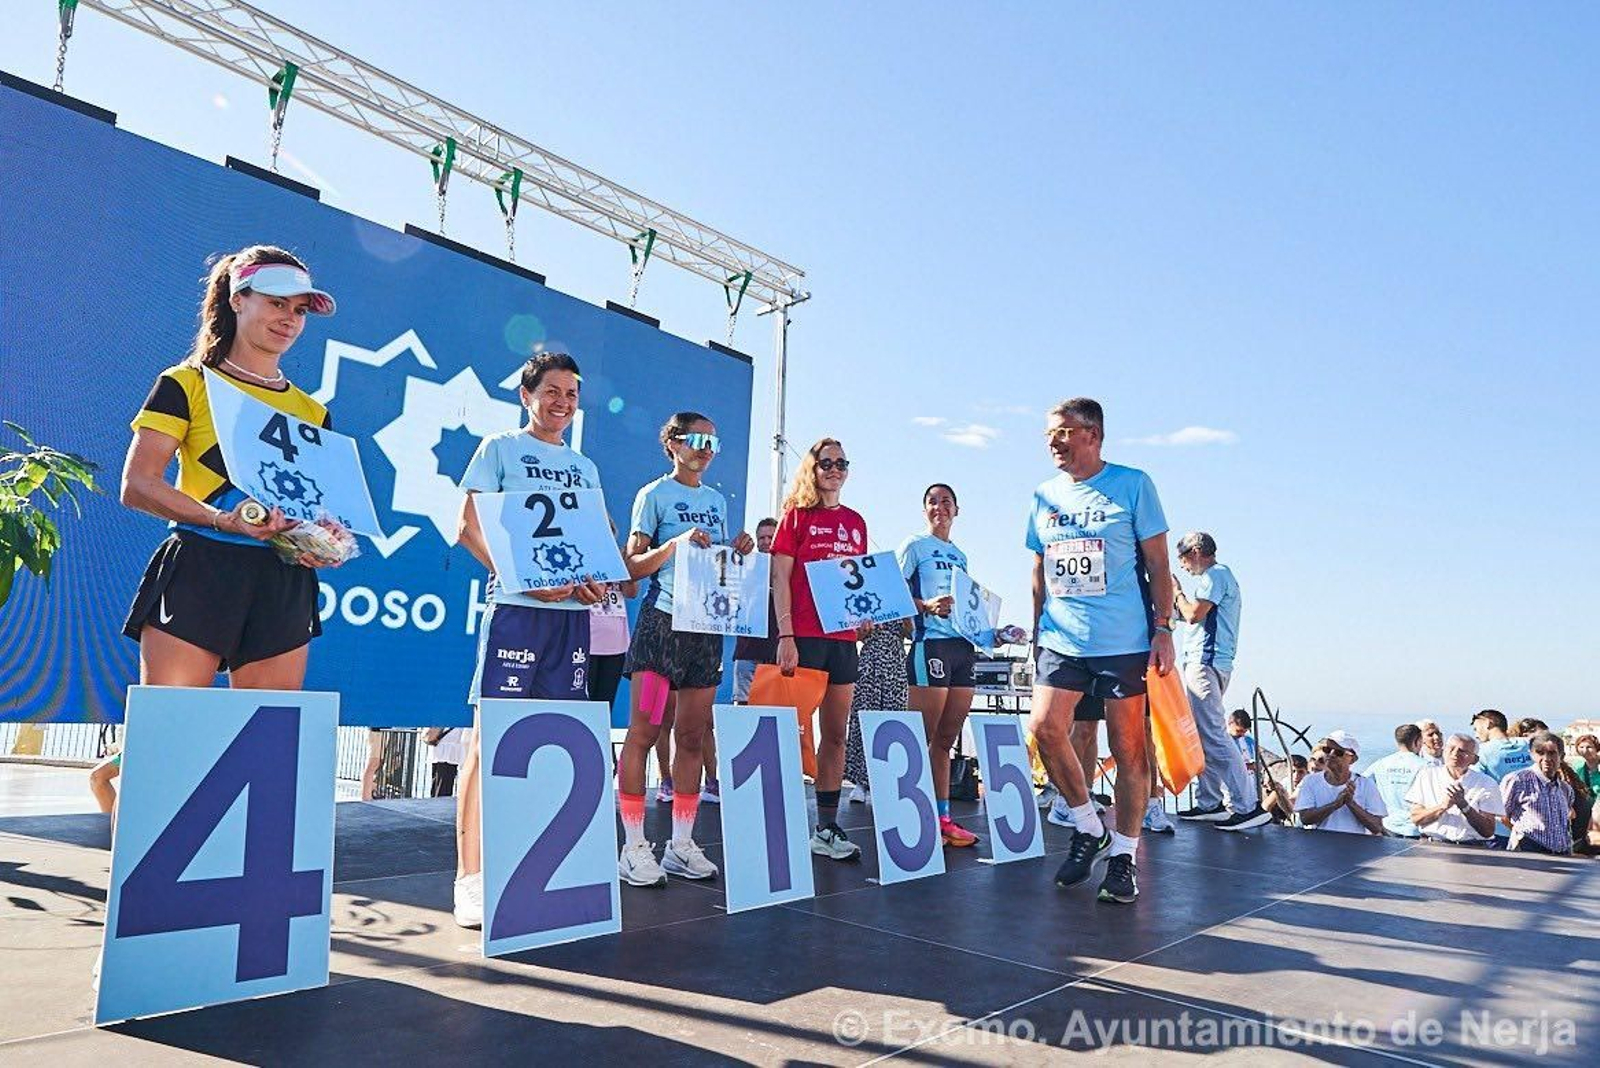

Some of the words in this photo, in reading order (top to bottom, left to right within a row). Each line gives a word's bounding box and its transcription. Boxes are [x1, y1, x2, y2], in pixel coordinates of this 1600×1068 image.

[525, 465, 582, 488] nerja
[679, 509, 721, 527] nerja
[1046, 505, 1106, 528] nerja
[1055, 556, 1092, 577] 509
[524, 575, 572, 589] Toboso
[573, 570, 609, 584] Hoels
[871, 611, 900, 621] Hotels
[497, 648, 536, 663] nerja
[872, 719, 937, 872] 3
[983, 724, 1037, 853] 5
[731, 716, 792, 893] 1
[489, 712, 613, 942] 2
[115, 706, 324, 983] 4
